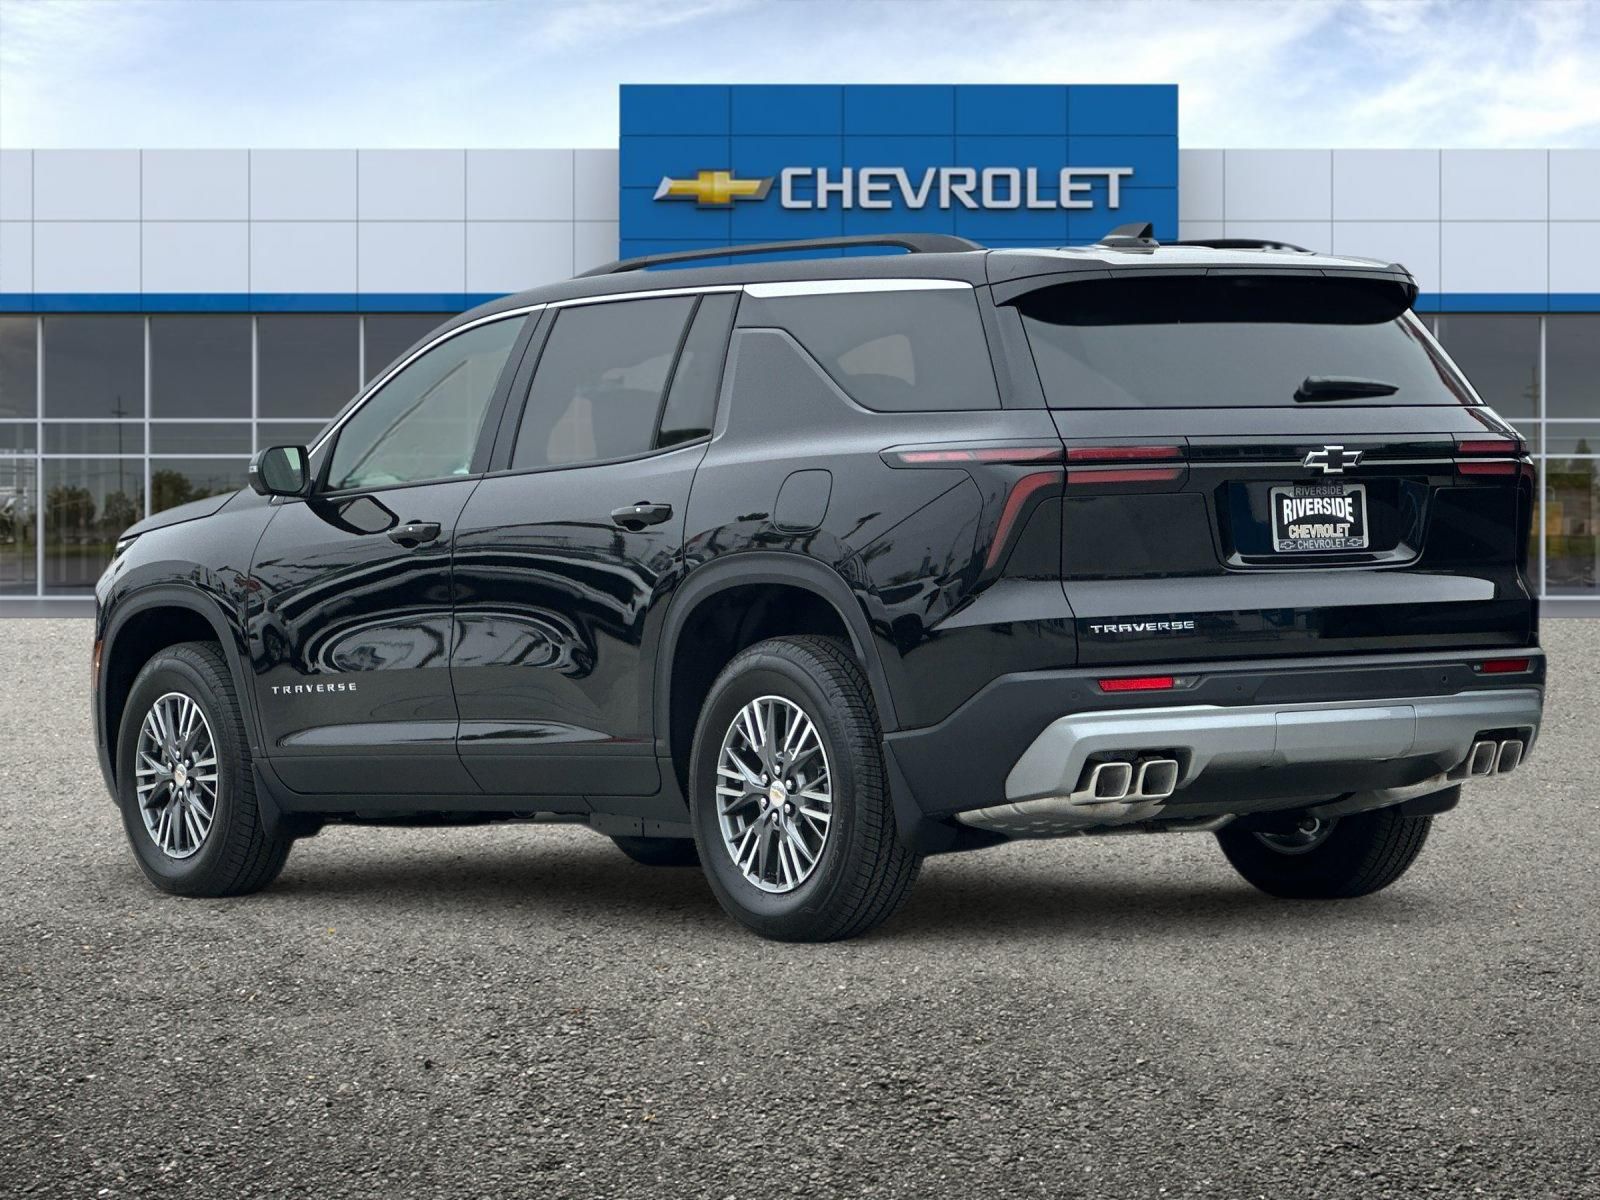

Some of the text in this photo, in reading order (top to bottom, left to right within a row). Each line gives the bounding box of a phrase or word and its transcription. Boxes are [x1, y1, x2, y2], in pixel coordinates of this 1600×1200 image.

[780, 166, 1134, 209] CHEVROLET
[1295, 485, 1342, 496] RIVERSIDE
[1282, 497, 1355, 525] RIVERSIDE
[1288, 523, 1351, 539] CHEVROLET
[1297, 538, 1346, 549] CHEVROLET
[1090, 620, 1195, 634] TRAVERSE
[271, 682, 357, 695] TRAVERSE
